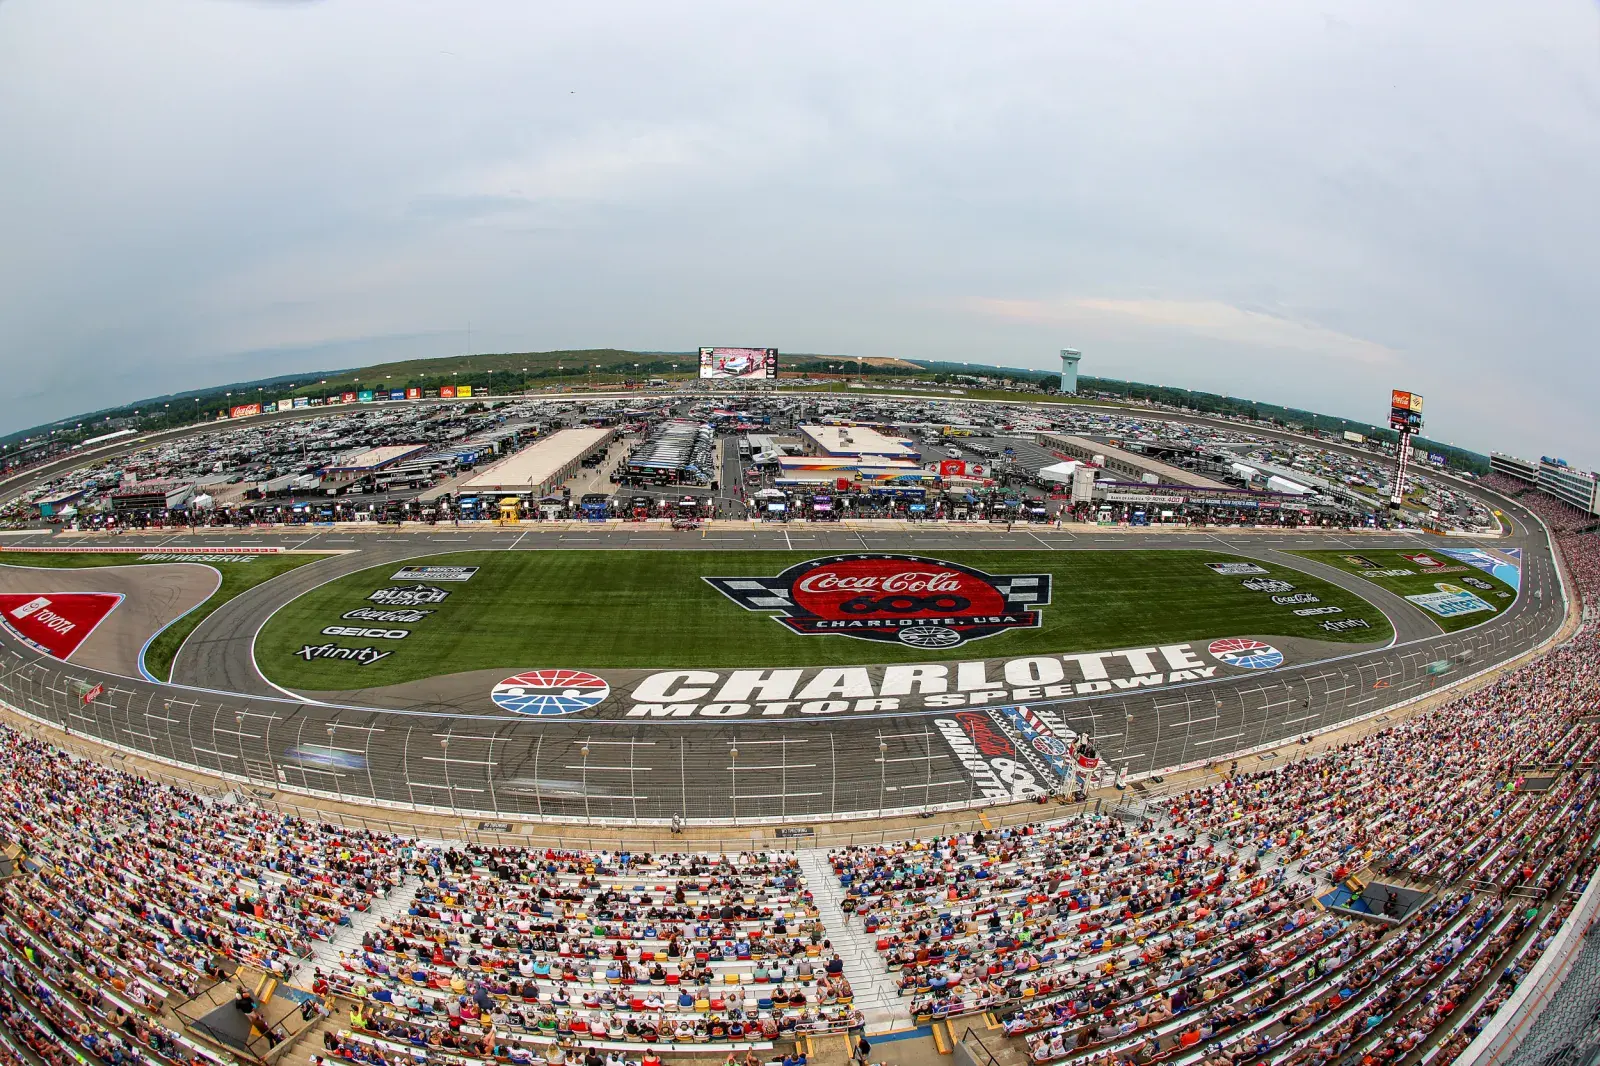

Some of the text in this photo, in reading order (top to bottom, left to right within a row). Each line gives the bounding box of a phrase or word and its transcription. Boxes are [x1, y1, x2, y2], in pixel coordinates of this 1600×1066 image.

[800, 572, 962, 593] Coca-Cola
[366, 588, 449, 602] BUSCH
[839, 595, 971, 613] 600
[34, 609, 76, 635] TOYOTA
[974, 615, 1017, 624] USA
[322, 626, 409, 639] GEICO
[296, 643, 391, 665] xfinity
[631, 644, 1205, 702] CHARLOTTE
[625, 666, 1217, 717] MOTOR SPEEDWAY
[934, 718, 1011, 798] CHARLOTTE
